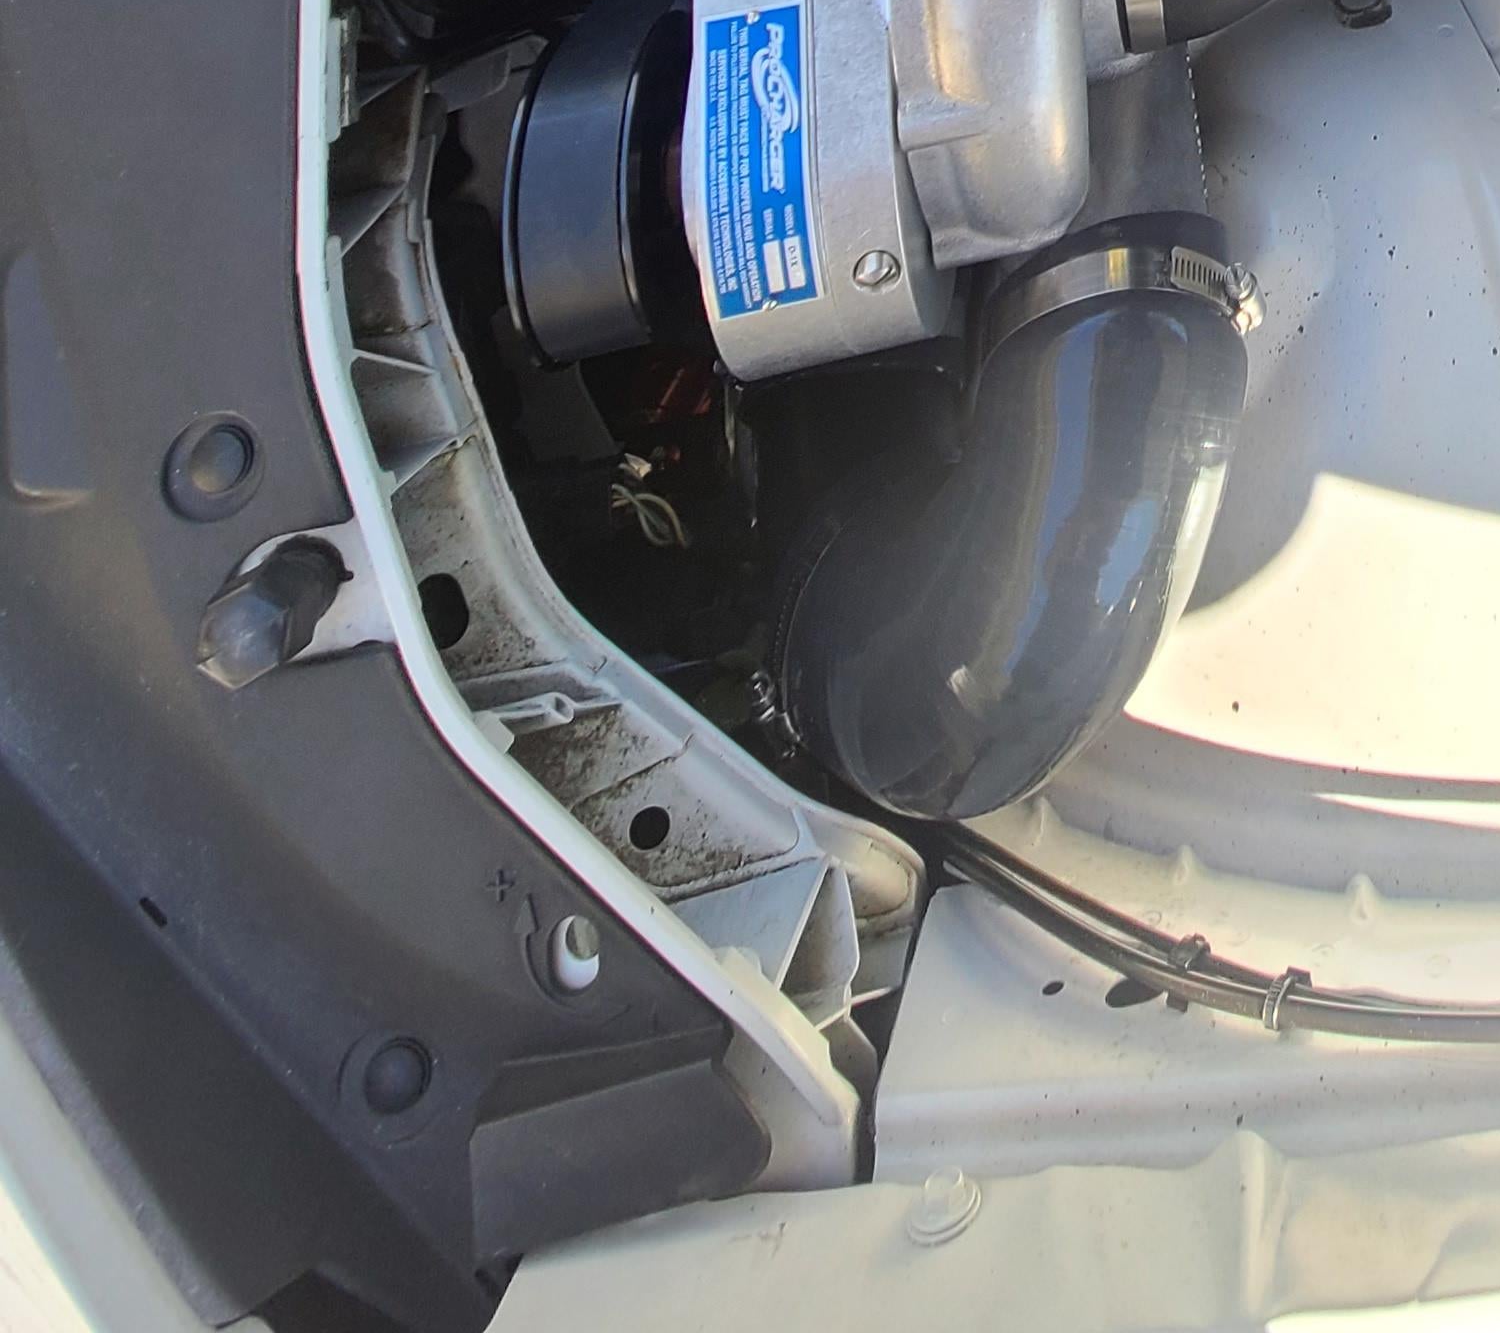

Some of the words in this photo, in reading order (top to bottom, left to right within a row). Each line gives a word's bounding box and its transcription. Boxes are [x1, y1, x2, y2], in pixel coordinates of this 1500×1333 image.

[717, 49, 727, 90] SERVICED
[739, 47, 749, 77] SERIAL
[717, 91, 727, 146] EXCLUSIVELY
[766, 22, 786, 191] PROCHARGER
[718, 147, 728, 159] BY
[718, 161, 729, 213] ACCESSIBLE
[740, 178, 752, 212] PROPER
[745, 242, 757, 260] AND
[747, 260, 762, 302] OPERATION
